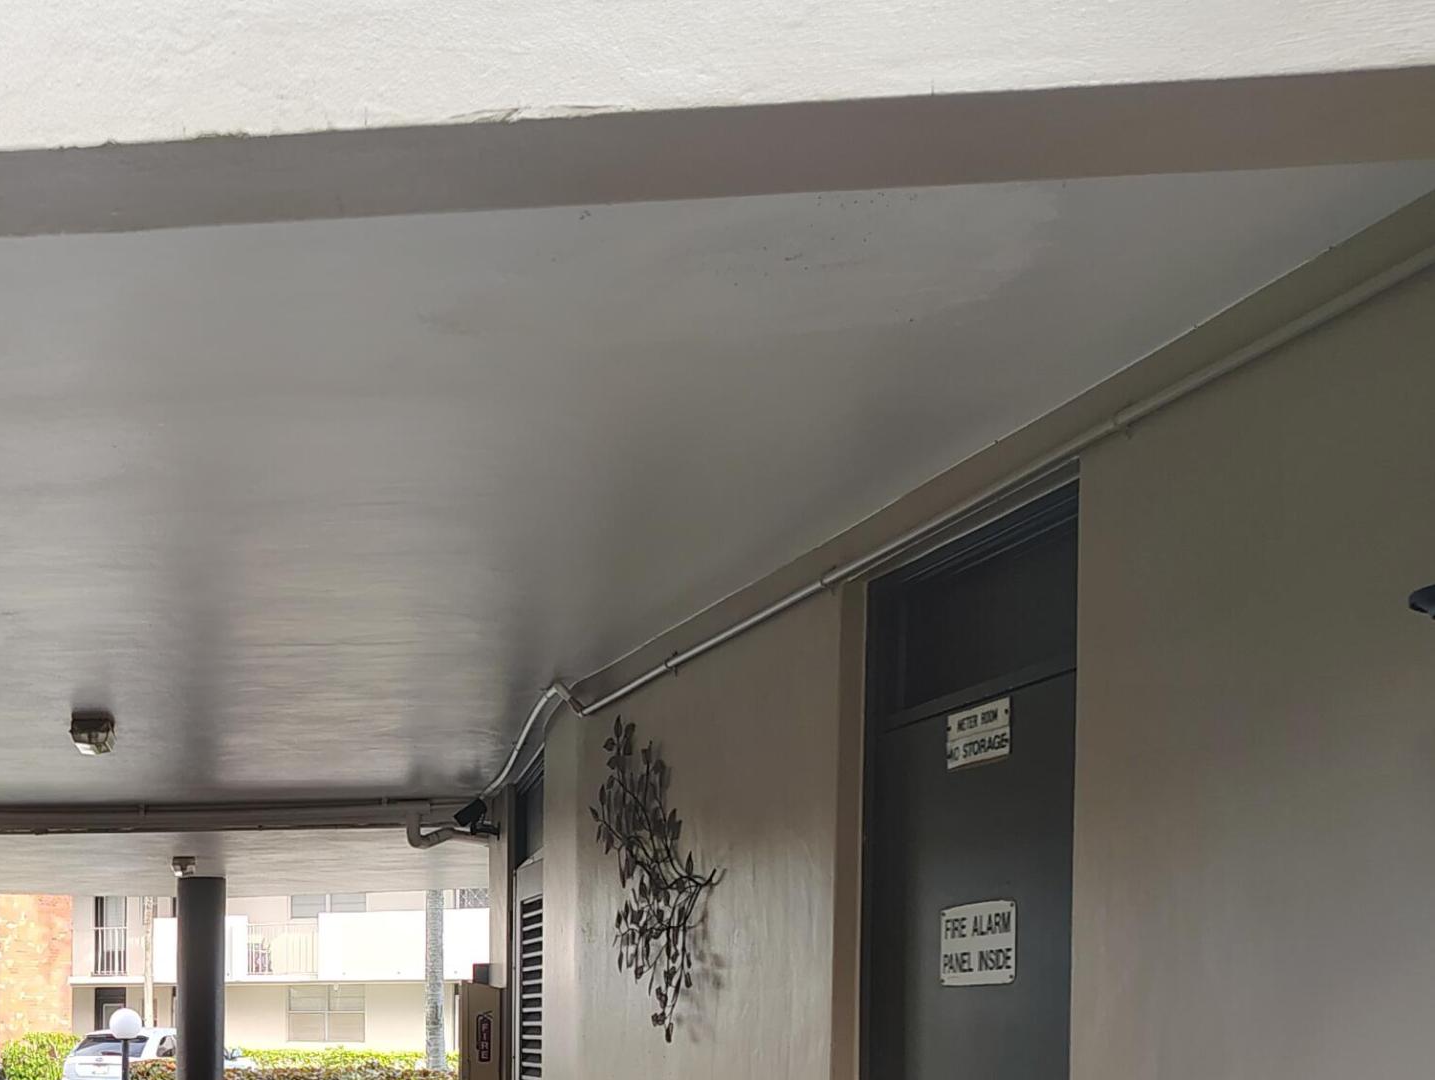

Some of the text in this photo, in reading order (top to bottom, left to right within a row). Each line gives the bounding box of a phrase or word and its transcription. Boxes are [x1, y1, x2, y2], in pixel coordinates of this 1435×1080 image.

[963, 733, 1007, 758] STORAGE
[945, 911, 1010, 939] FIRE ALARM
[943, 948, 1012, 973] PANEL INSIDE
